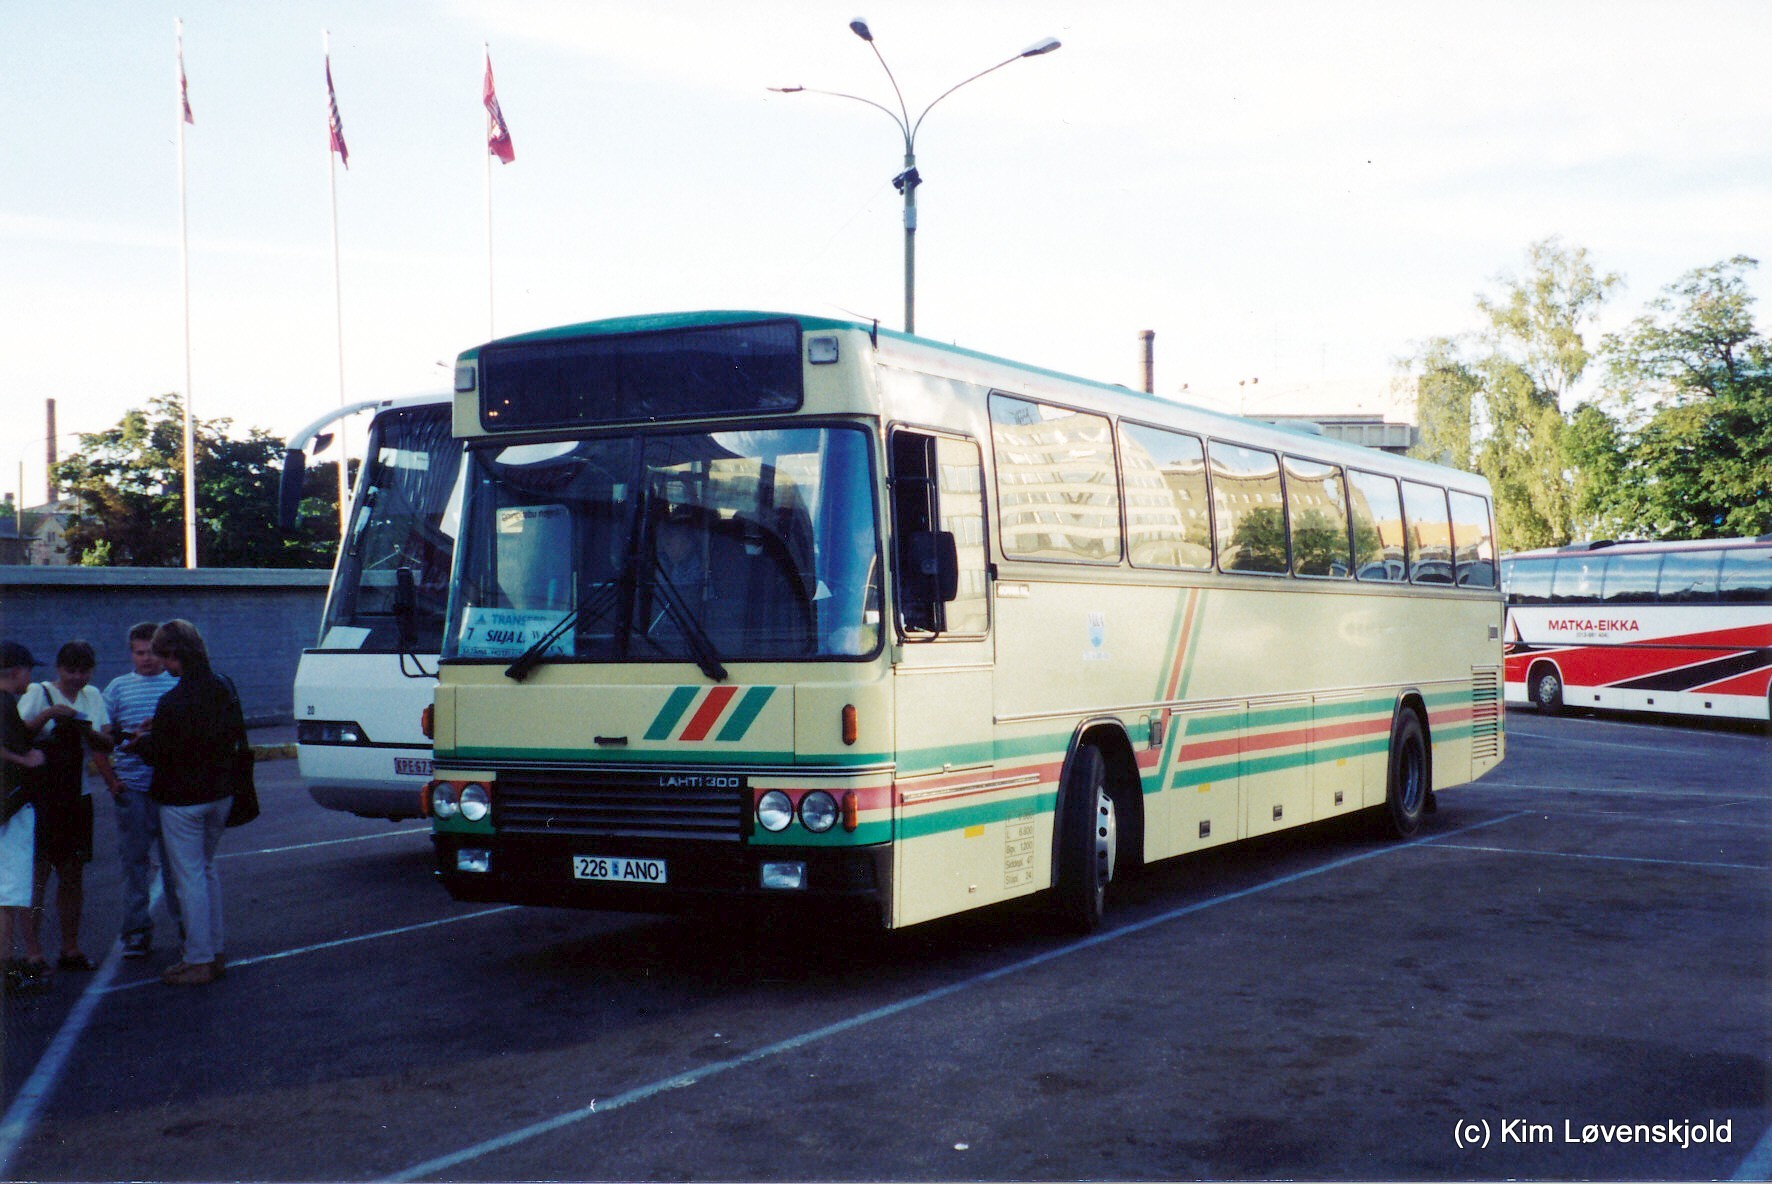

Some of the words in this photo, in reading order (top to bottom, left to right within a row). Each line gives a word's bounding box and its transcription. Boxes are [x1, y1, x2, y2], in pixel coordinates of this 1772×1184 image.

[1548, 619, 1640, 631] MATKA-EIKKA
[486, 629, 514, 644] SILJA
[660, 776, 702, 787] LAHTI
[706, 776, 739, 788] 300
[580, 859, 608, 878] 226
[623, 861, 660, 881] ANO
